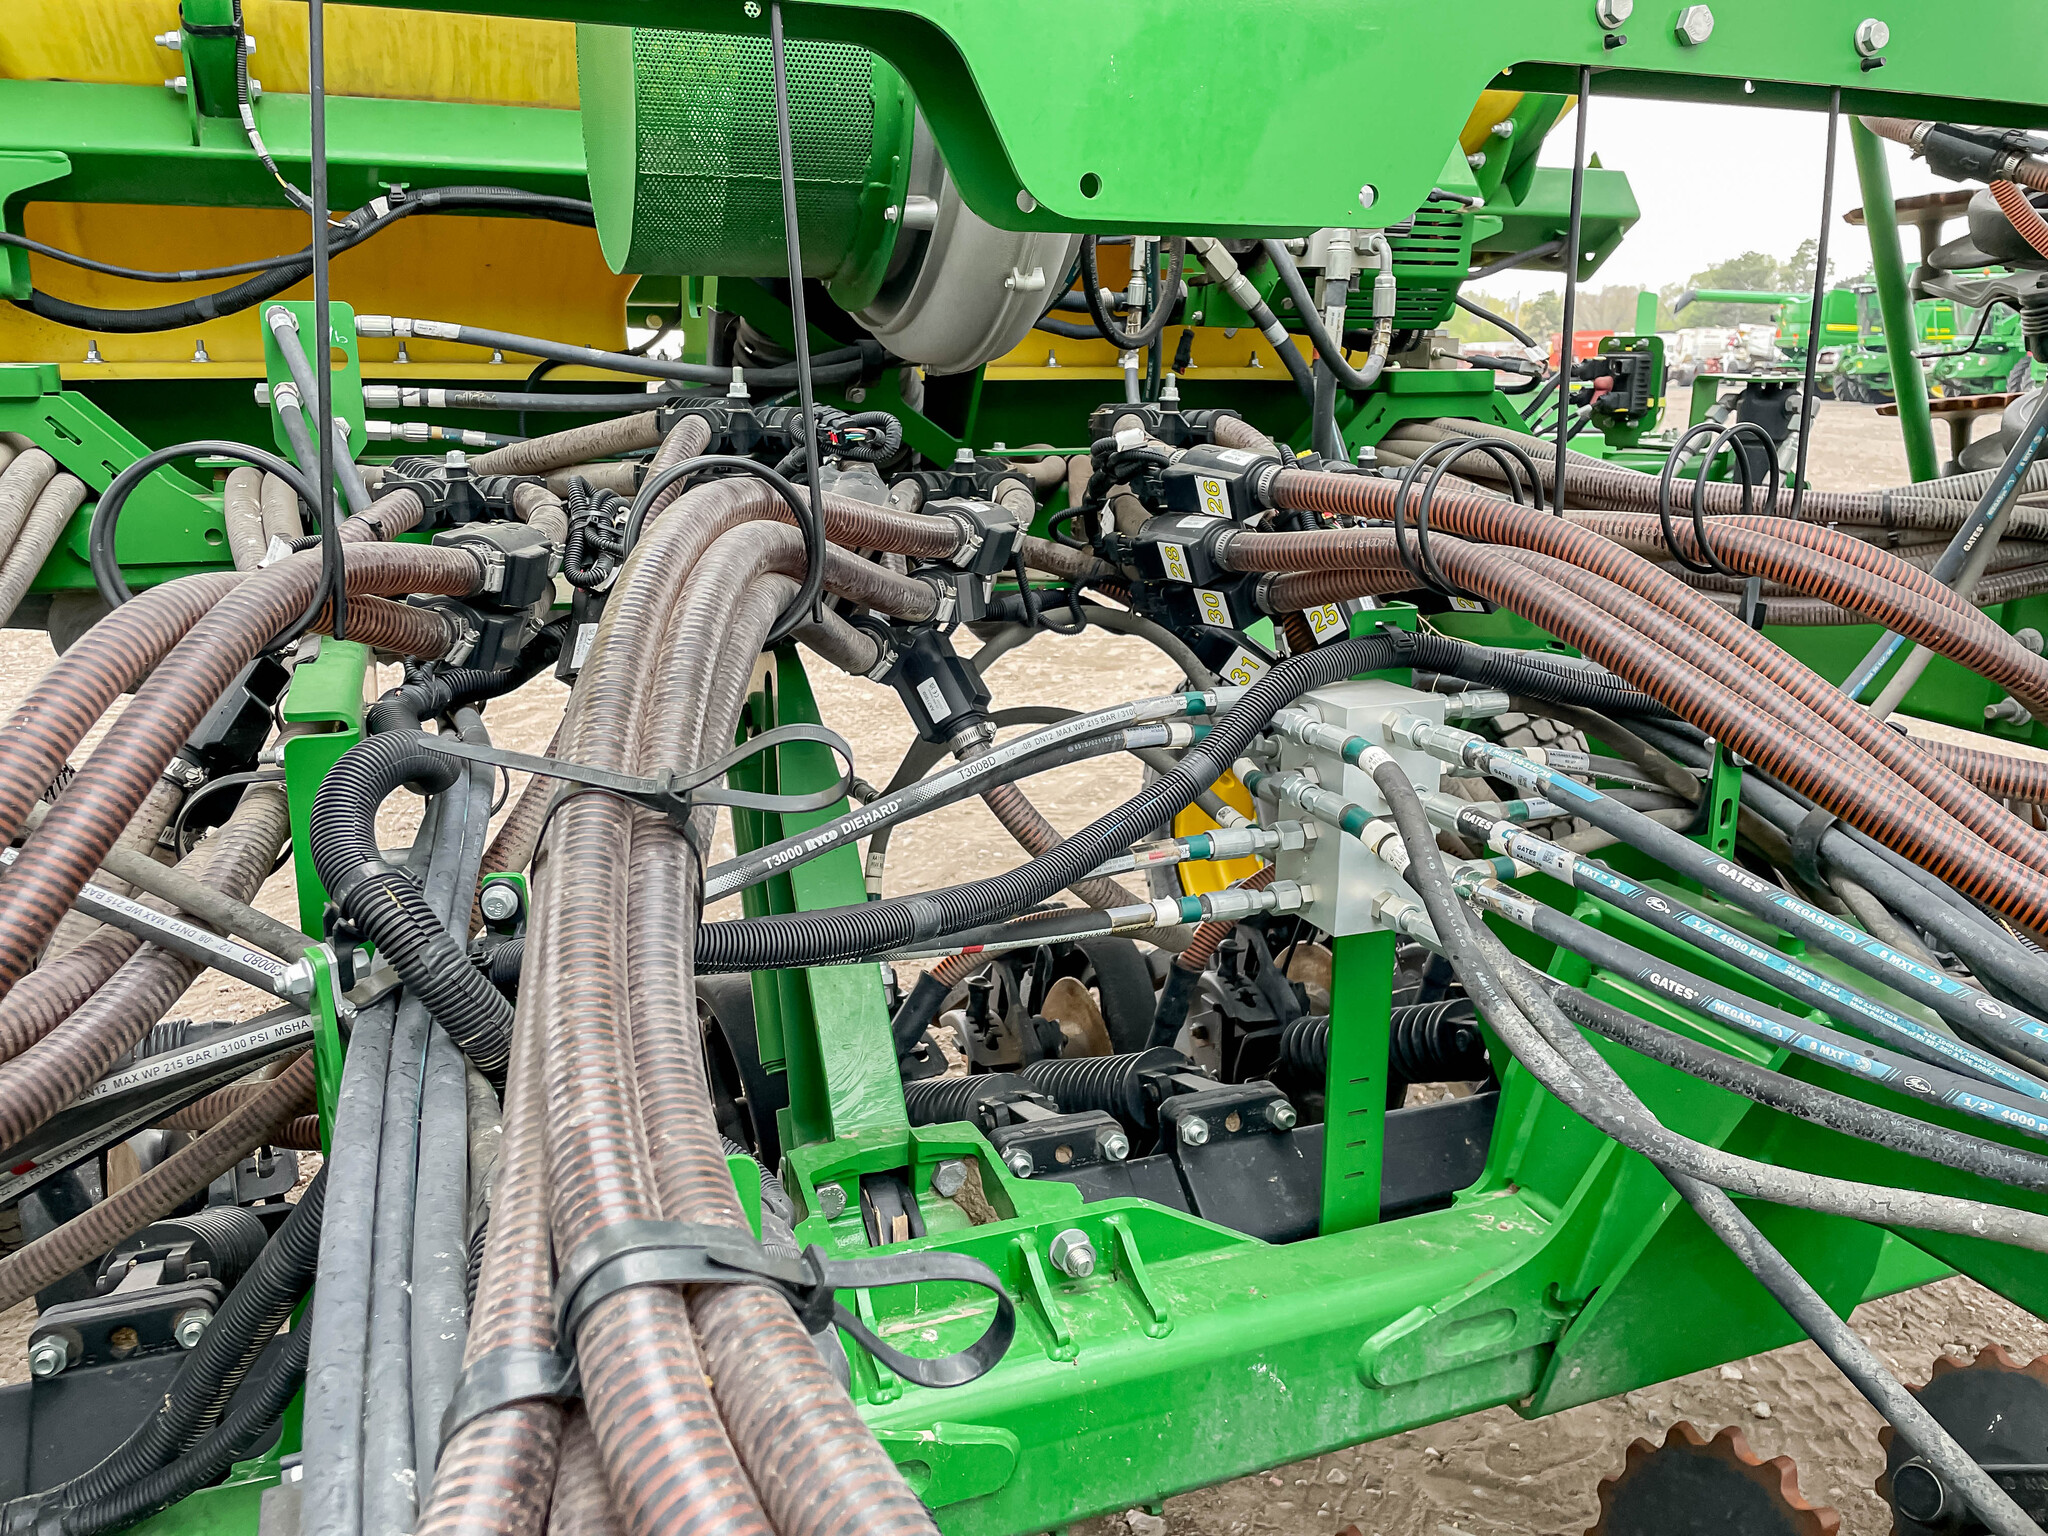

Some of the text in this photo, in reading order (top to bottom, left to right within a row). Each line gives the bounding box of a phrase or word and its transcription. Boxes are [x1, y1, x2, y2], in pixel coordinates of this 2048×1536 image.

[1207, 479, 1225, 514] 26
[1963, 527, 1984, 552] GATES
[1167, 546, 1185, 580] 28
[1203, 593, 1225, 625] 30
[1458, 597, 1475, 609] 2
[1309, 604, 1339, 634] 25
[1231, 656, 1260, 685] 31
[957, 756, 997, 780] T3008D
[1034, 733, 1054, 747] DN12
[1056, 727, 1074, 739] MAX
[1073, 722, 1086, 734] WP
[1087, 718, 1100, 728] 215
[1100, 713, 1117, 724] BAR
[1462, 812, 1494, 831] GATES
[763, 845, 803, 870] T3000
[1517, 845, 1537, 857] GATES
[1573, 862, 1580, 871] 8
[82, 886, 106, 899] BAR
[105, 897, 124, 908] 215
[123, 904, 144, 917] WP
[137, 911, 168, 926] MAX
[170, 924, 198, 938] DN12
[1720, 932, 1749, 952] 4000
[1749, 948, 1769, 961] psi
[1880, 950, 1889, 959] 8
[1827, 991, 1840, 1000] mm
[1851, 996, 1863, 1004] ISO
[1650, 972, 1696, 1000] GATES
[1809, 1041, 1817, 1050] 8
[1849, 1001, 1870, 1015] Meets
[1870, 1012, 1908, 1034] Performance
[1916, 1033, 1926, 1042] EN
[1960, 1055, 1974, 1065] SAE
[1973, 1063, 1996, 1076] 100R2
[1923, 1031, 1938, 1040] SAE
[113, 1069, 140, 1088] MAX
[141, 1064, 161, 1080] WP
[164, 1057, 184, 1073] 215
[186, 1049, 212, 1065] BAR
[220, 1038, 247, 1054] 3100
[249, 1031, 269, 1045] PSI
[275, 1019, 310, 1037] MSHA
[2001, 1109, 2036, 1127] 4000
[29, 1161, 55, 1180] FRAS
